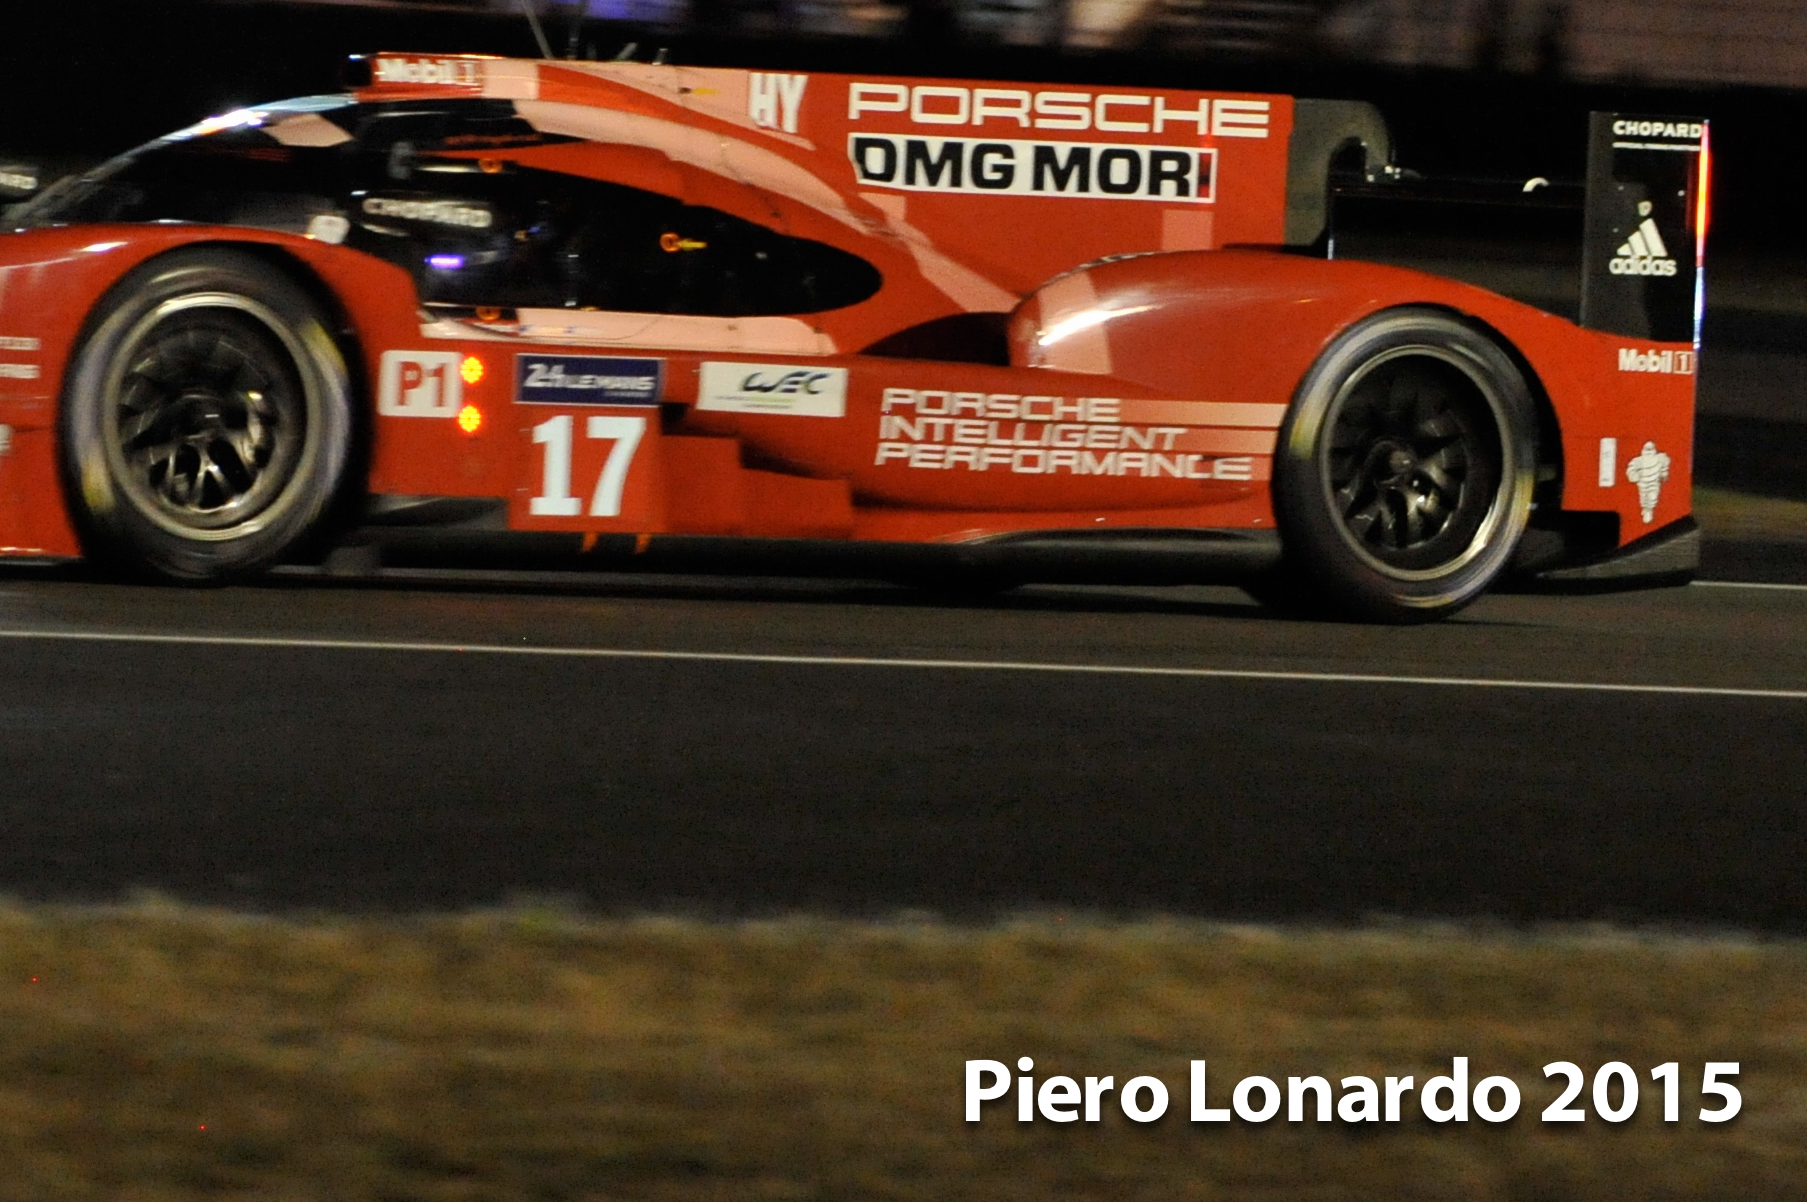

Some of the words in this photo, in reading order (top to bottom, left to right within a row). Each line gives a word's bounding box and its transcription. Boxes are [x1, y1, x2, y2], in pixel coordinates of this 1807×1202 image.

[749, 72, 808, 134] HY
[848, 82, 1270, 138] PORSCHE
[1612, 120, 1702, 138] CHOPARD
[854, 137, 1015, 189] DMG
[1032, 145, 1212, 197] MORI
[1609, 254, 1677, 276] adidas
[1618, 348, 1673, 373] Mobil
[397, 362, 446, 408] P1
[742, 371, 830, 395] WEC
[881, 387, 1121, 423] PORSCHE
[879, 415, 1187, 451] INTELLIGENT
[530, 415, 646, 516] 17
[874, 442, 1253, 481] PERFORMANCE
